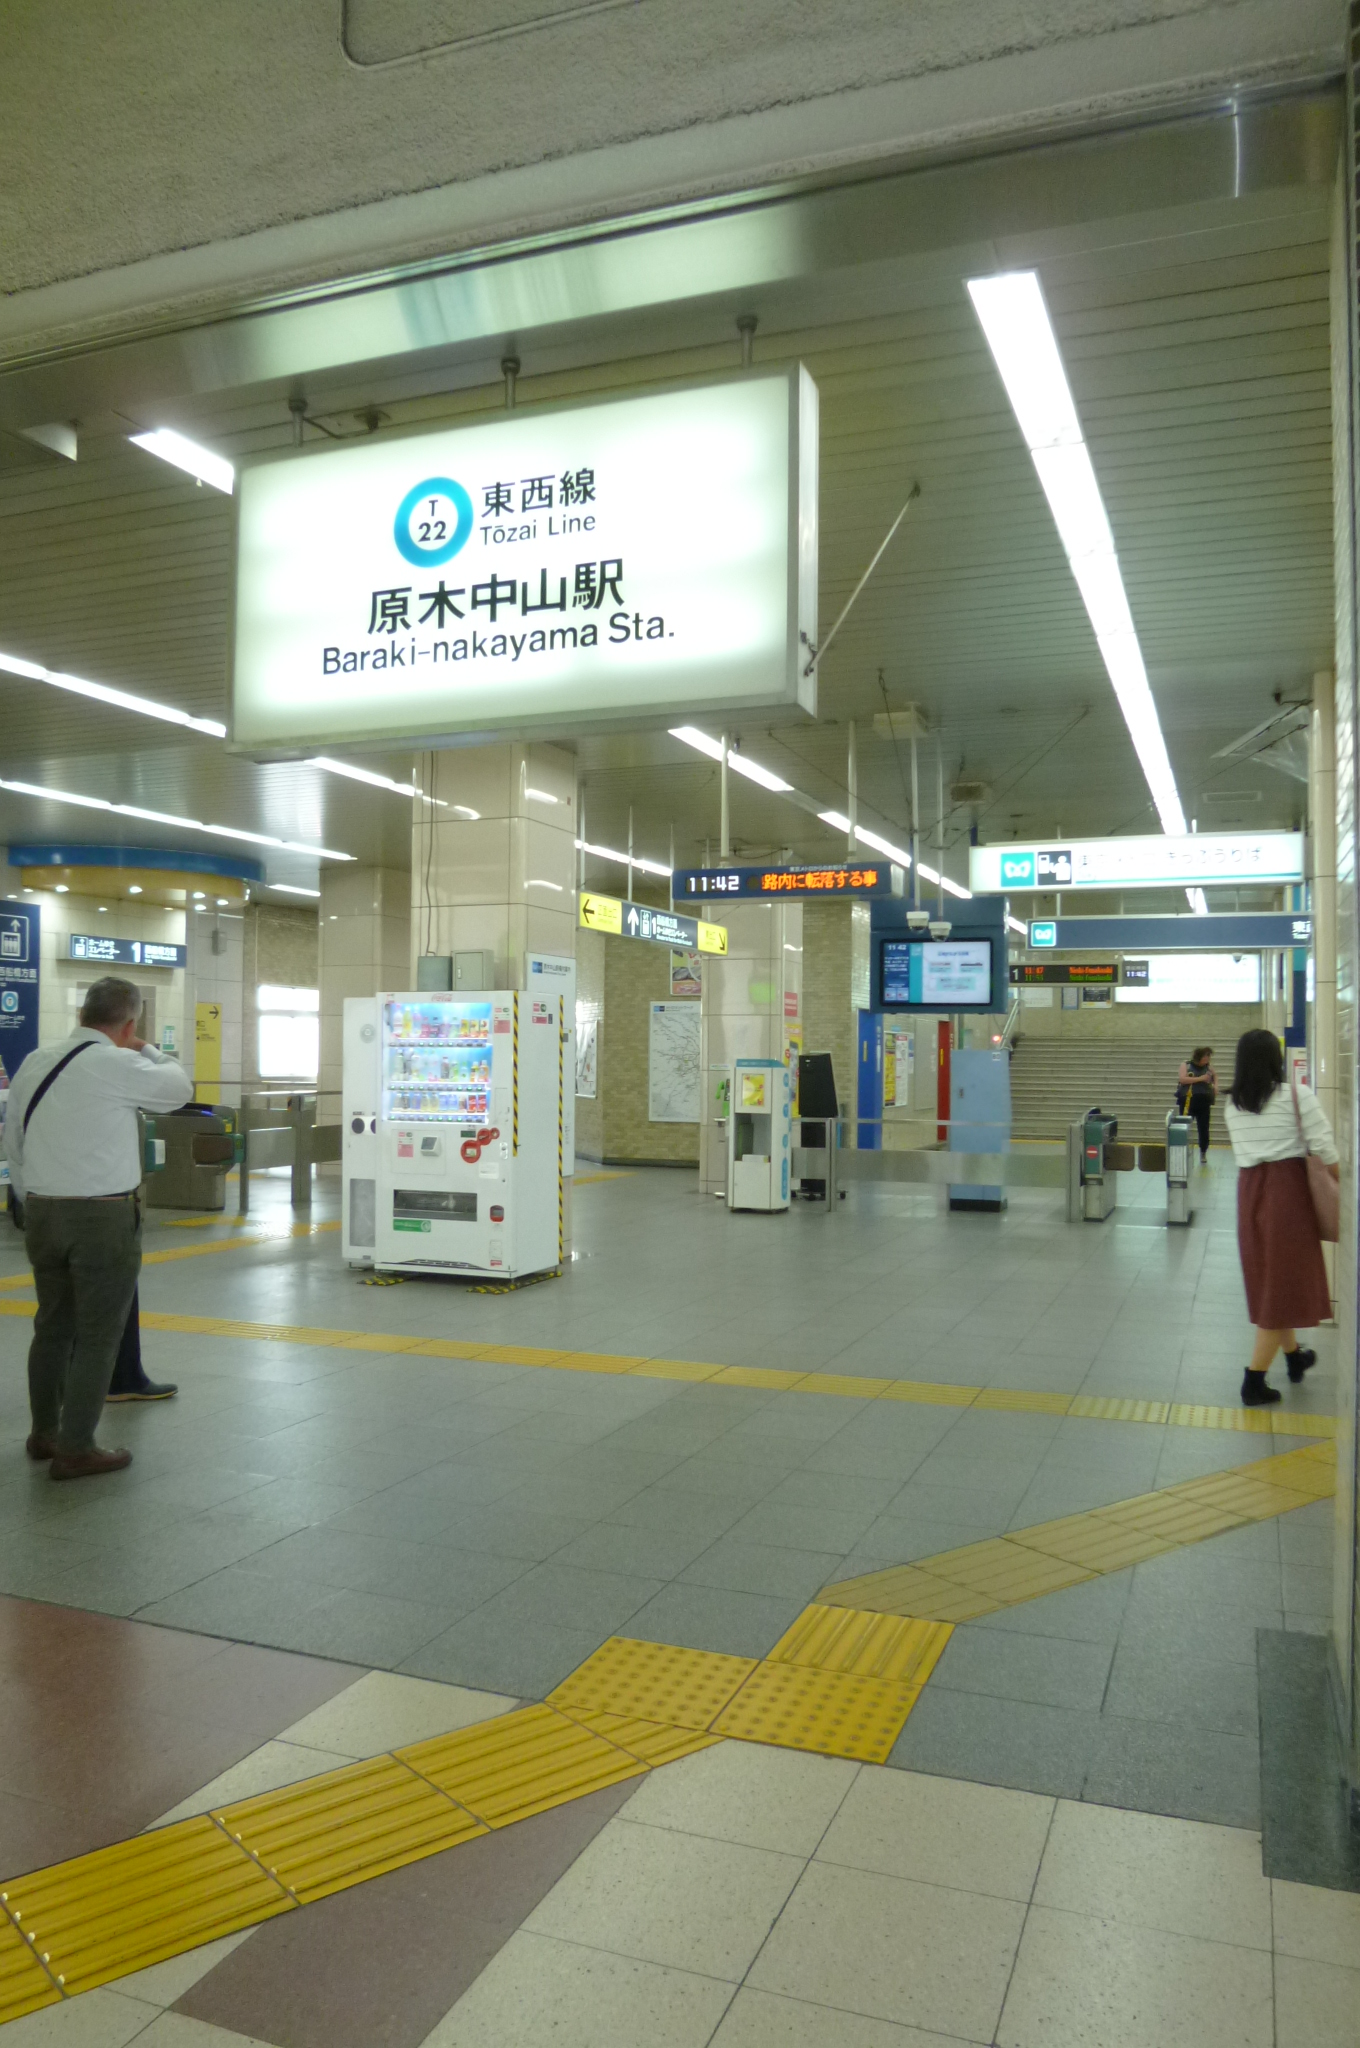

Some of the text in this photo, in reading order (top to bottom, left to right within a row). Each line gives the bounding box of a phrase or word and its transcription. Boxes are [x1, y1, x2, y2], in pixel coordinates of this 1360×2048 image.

[481, 467, 597, 518] 東西線
[428, 499, 439, 517] T
[417, 520, 447, 542] 22
[479, 513, 597, 546] Tōzai Line
[367, 557, 625, 636] 原木中山駅
[322, 611, 676, 676] Baraki-nakayama Sta.
[689, 875, 740, 892] 11:42
[131, 942, 142, 963] 1
[1012, 968, 1019, 981] 1
